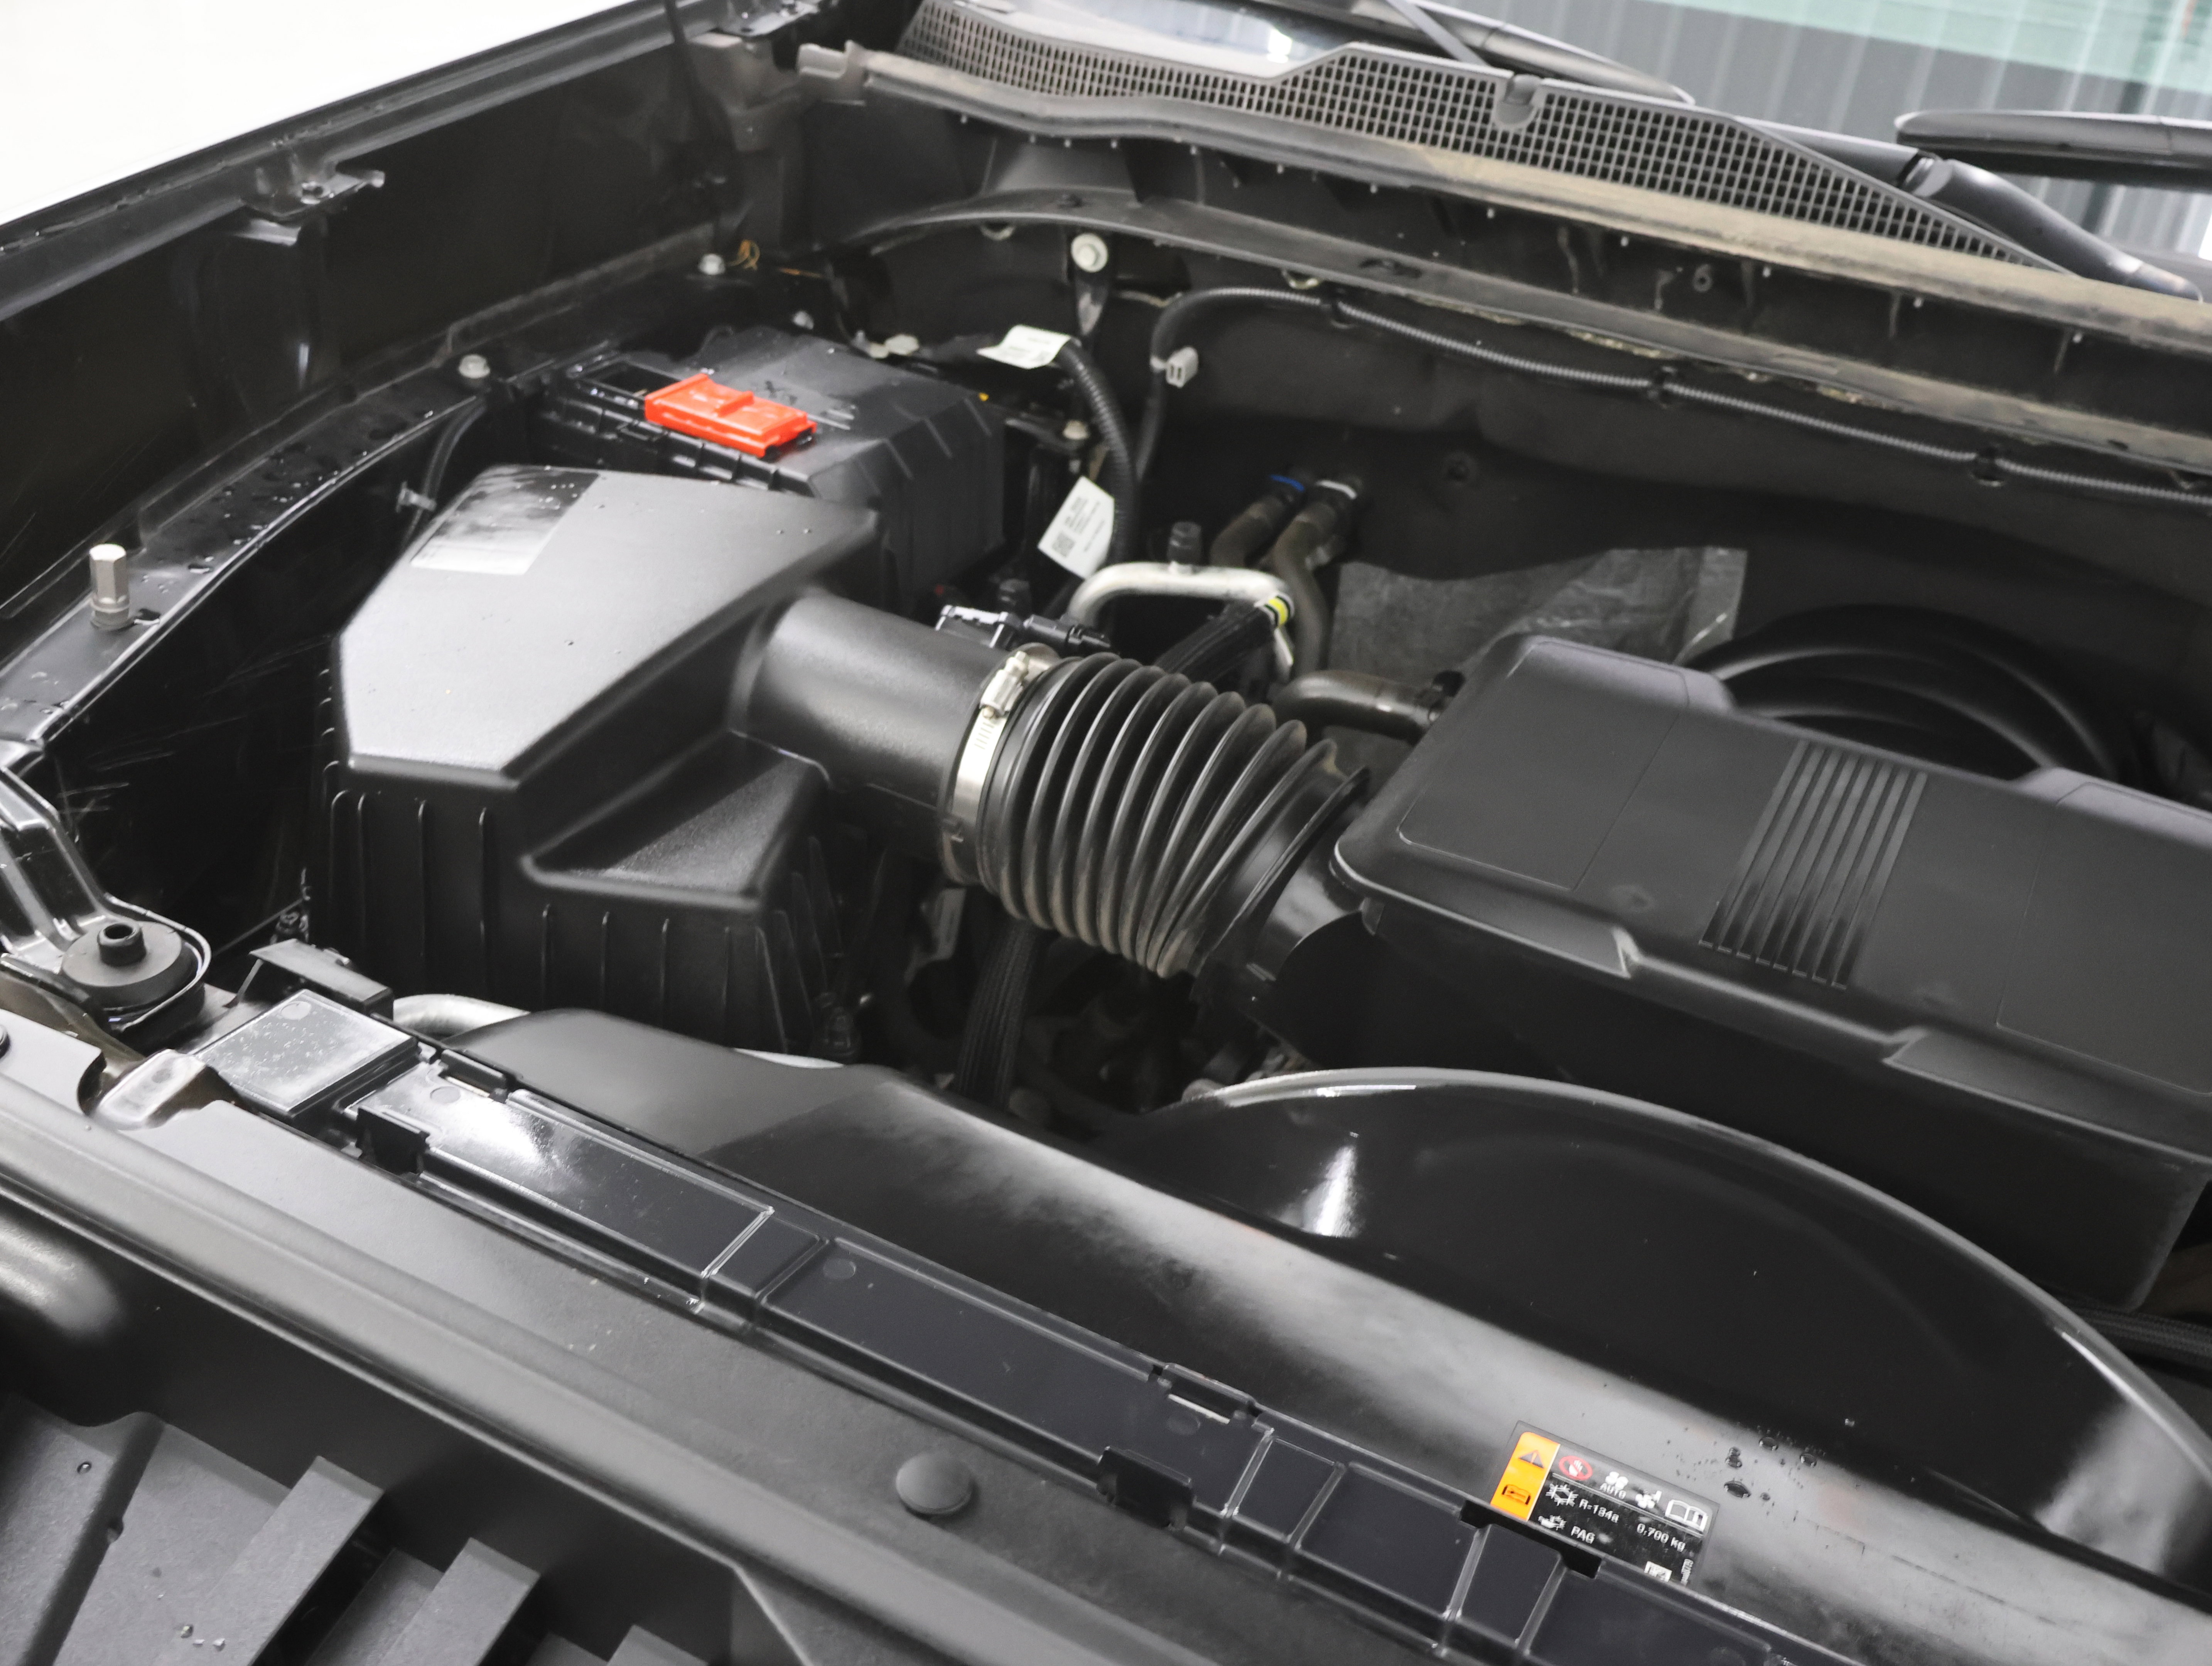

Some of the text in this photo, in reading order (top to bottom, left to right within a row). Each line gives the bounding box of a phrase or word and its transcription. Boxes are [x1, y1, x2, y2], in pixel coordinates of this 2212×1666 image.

[1599, 1483, 1627, 1499] AUTO
[1571, 1525, 1595, 1544] PAG
[1670, 1537, 1686, 1552] kg
